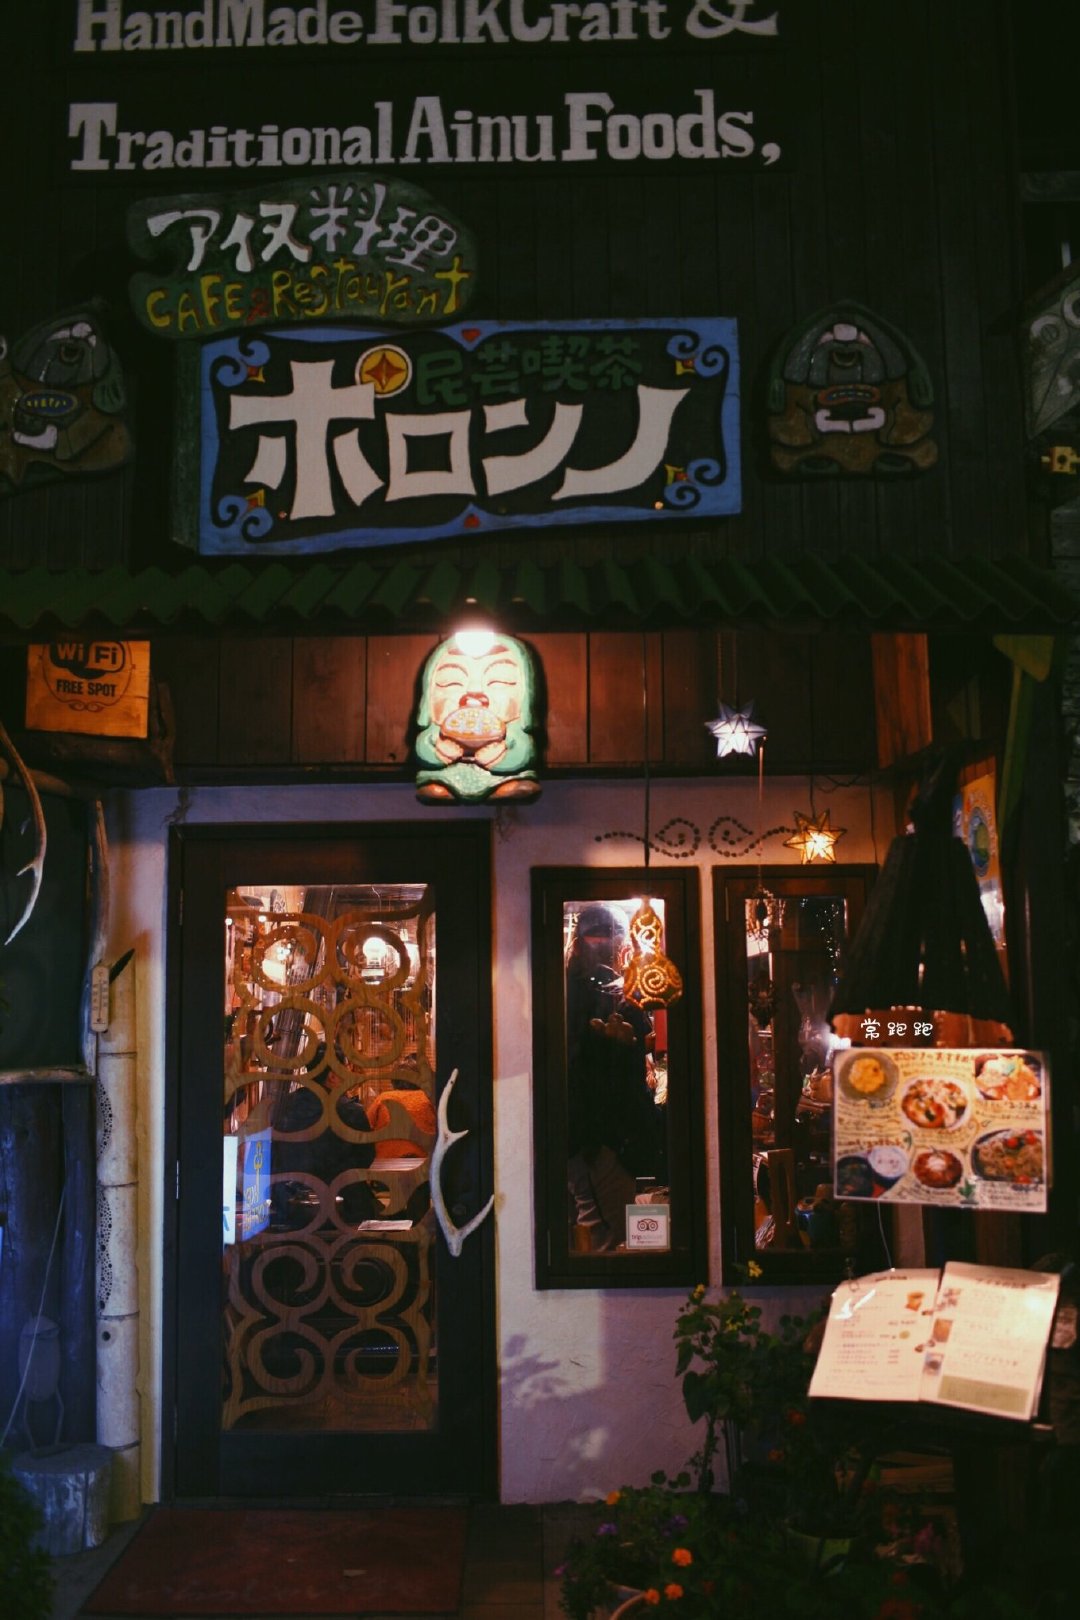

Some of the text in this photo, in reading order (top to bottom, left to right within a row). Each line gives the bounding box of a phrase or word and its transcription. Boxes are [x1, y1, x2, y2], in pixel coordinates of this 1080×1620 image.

[68, 88, 782, 171] Traditional Ainu Foods,
[146, 181, 459, 274] アイヌ料理
[145, 272, 246, 333] CAFE
[416, 334, 644, 408] 民芸喫茶
[56, 679, 118, 697] FREE SPOT
